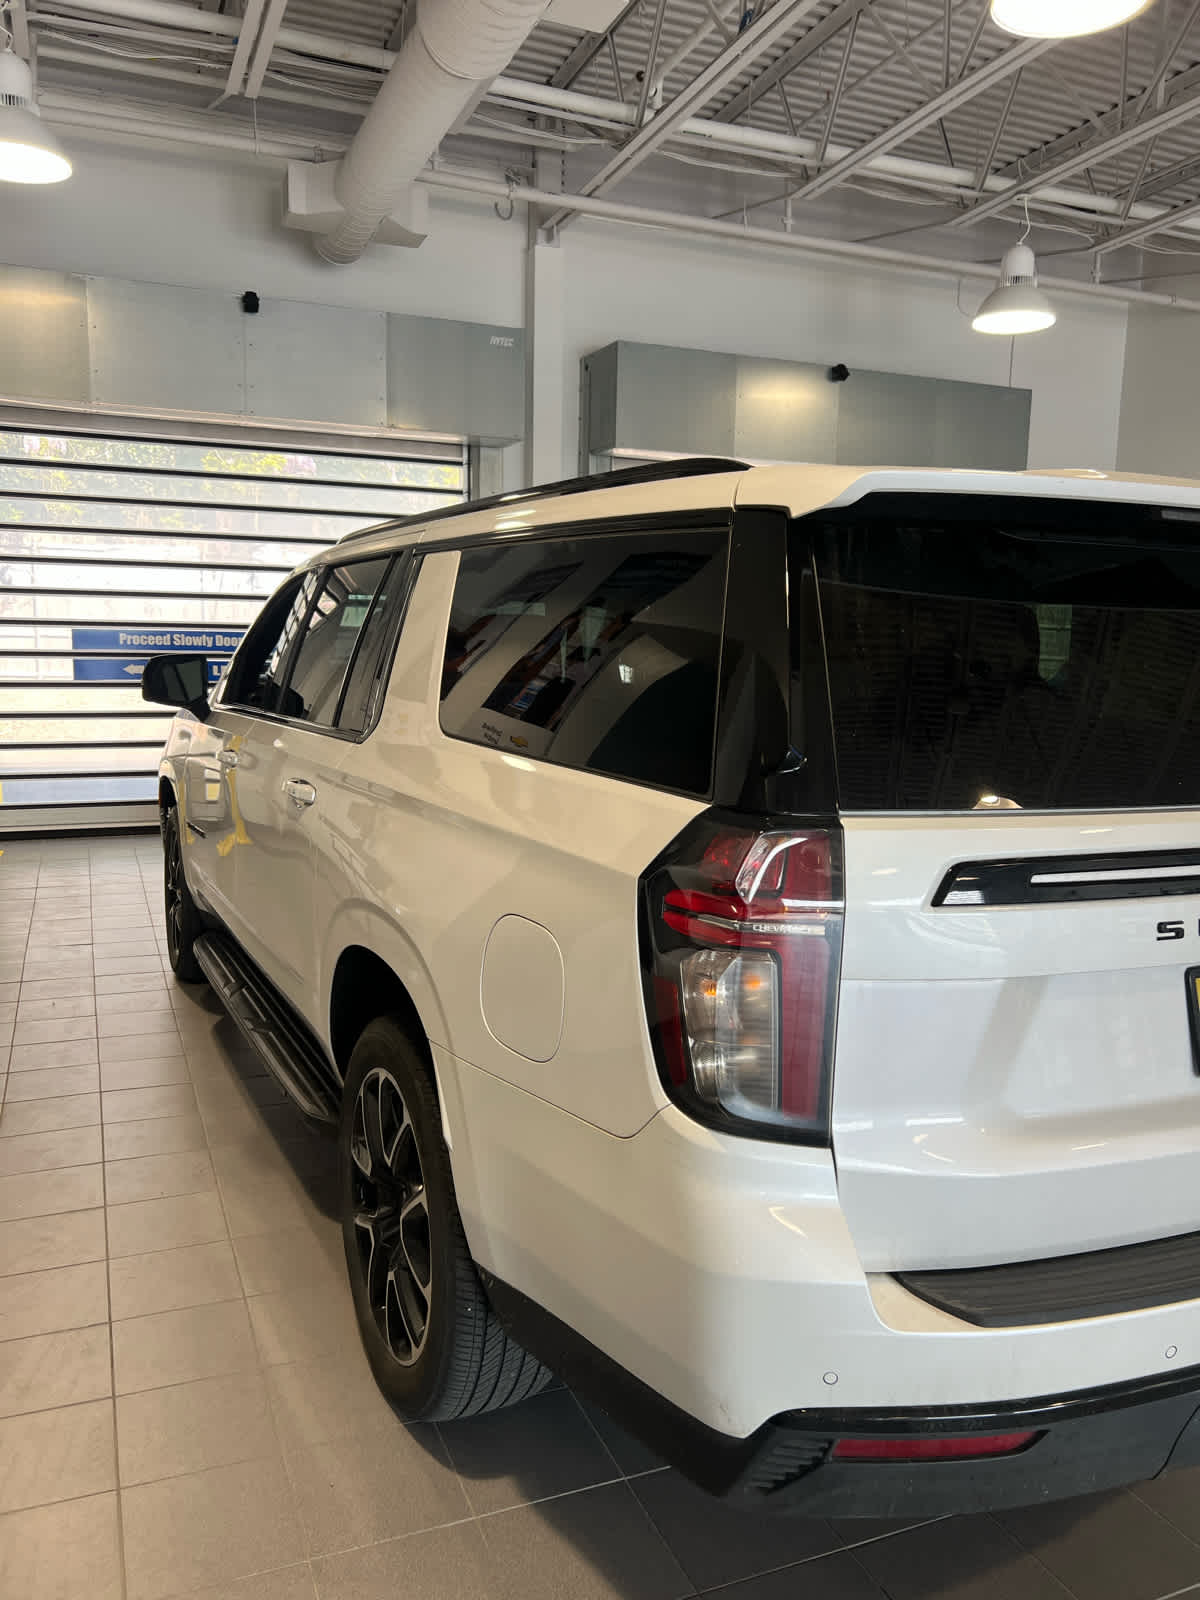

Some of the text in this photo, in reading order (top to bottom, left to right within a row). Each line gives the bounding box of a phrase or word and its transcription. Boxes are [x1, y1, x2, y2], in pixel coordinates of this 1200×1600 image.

[119, 632, 171, 645] Proceed
[173, 633, 213, 647] Slowly
[1156, 918, 1200, 941] S
